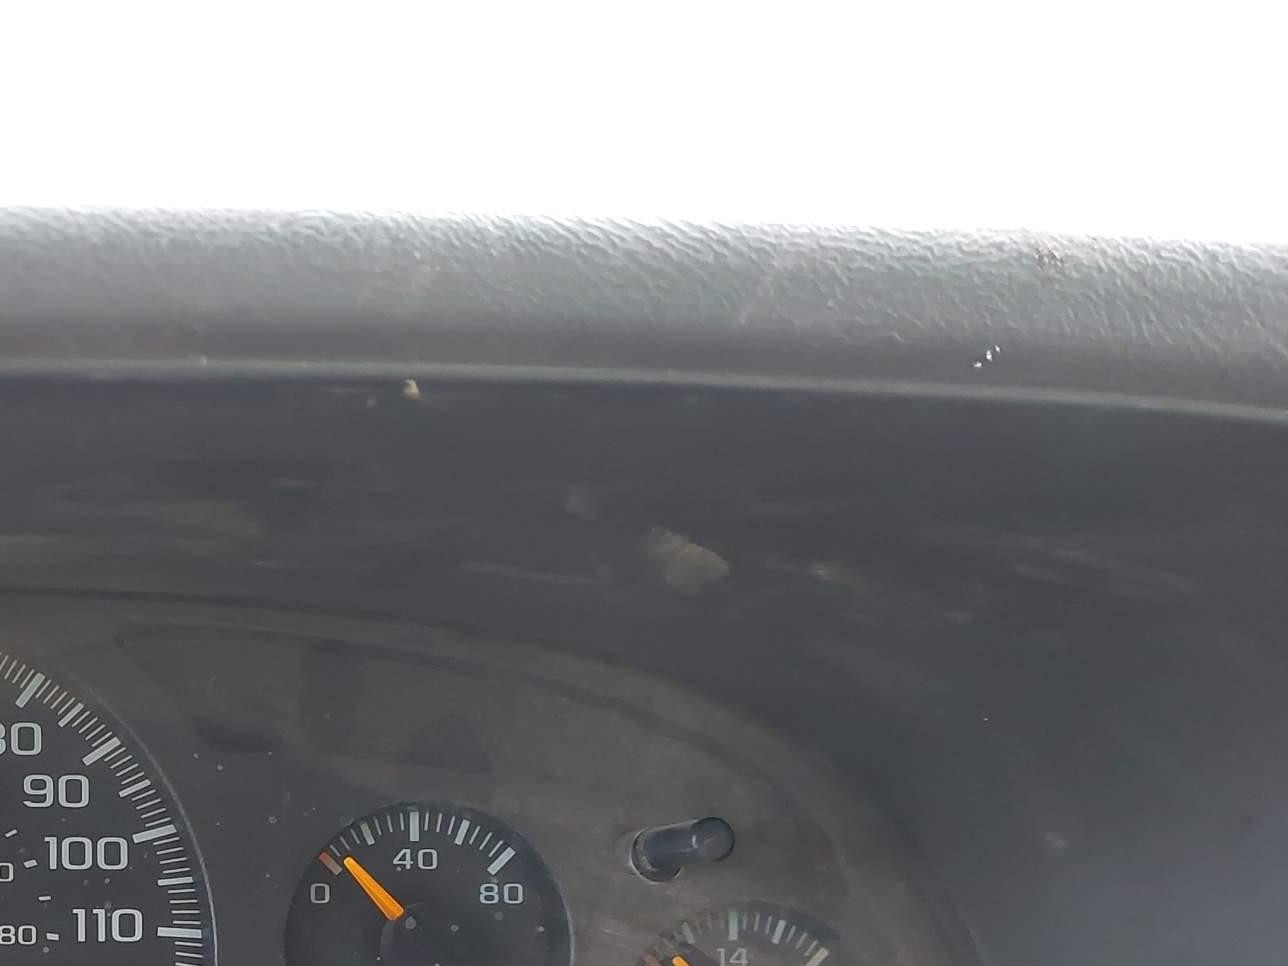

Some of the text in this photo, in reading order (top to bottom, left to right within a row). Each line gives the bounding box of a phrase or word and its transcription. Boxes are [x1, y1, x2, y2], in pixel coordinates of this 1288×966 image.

[24, 775, 89, 807] 90
[45, 837, 127, 869] 100
[393, 849, 437, 869] 40
[311, 884, 329, 903] 0
[480, 884, 523, 903] 80
[73, 909, 142, 941] 110
